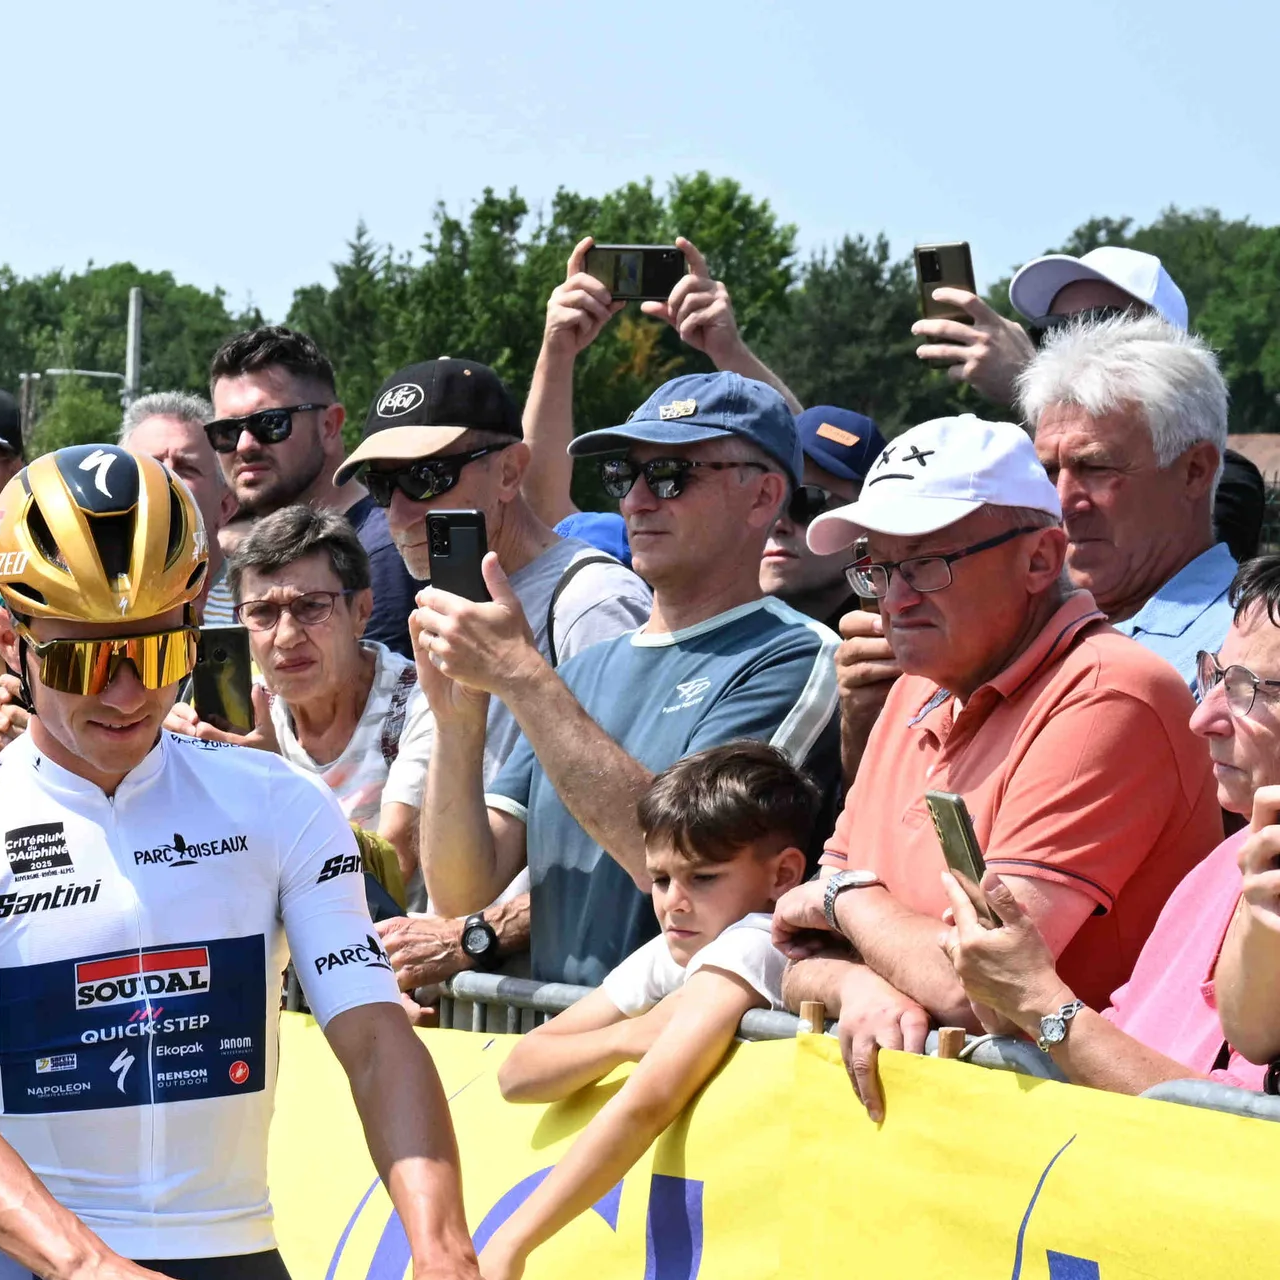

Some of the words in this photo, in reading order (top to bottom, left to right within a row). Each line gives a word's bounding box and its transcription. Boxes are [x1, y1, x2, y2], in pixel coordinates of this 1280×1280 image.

[134, 847, 173, 866] PARC
[189, 835, 249, 859] OISEAUX
[30, 859, 52, 871] 2025
[314, 945, 370, 975] PARC
[77, 970, 208, 1007] SOUDAL
[156, 1042, 203, 1057] Ekopak
[220, 1037, 252, 1050] JANOM
[157, 1068, 207, 1081] RENSON
[27, 1082, 91, 1096] NAPOLEON
[157, 1078, 208, 1088] OUTDOOR
